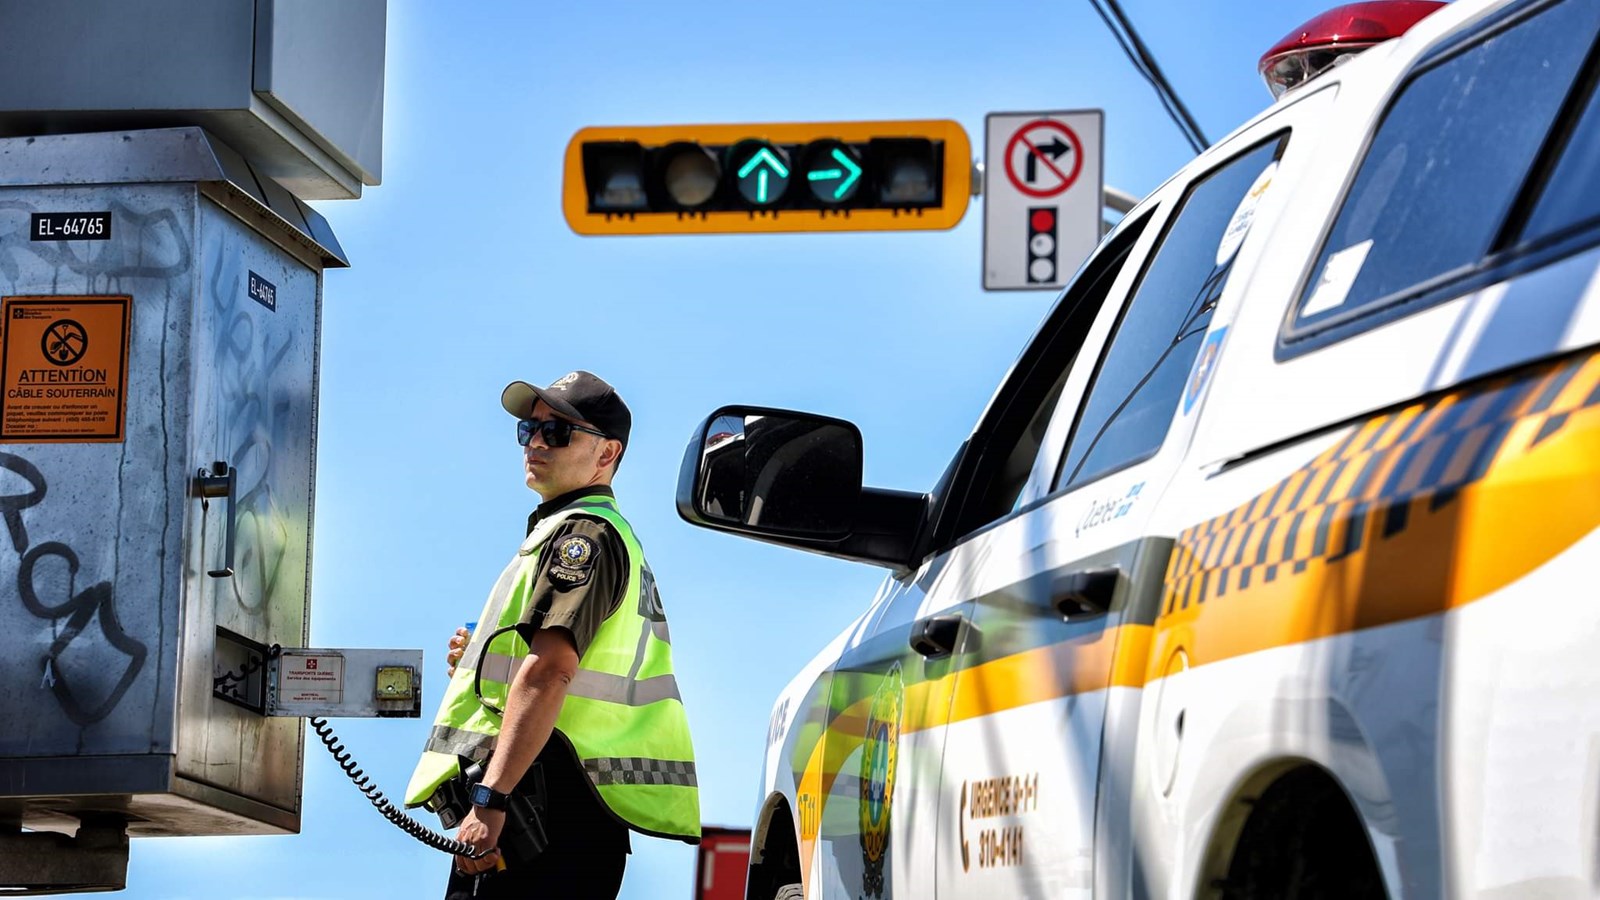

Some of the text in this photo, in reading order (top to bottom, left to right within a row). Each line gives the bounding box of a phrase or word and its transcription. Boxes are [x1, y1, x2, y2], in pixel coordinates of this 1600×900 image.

[39, 217, 104, 236] EL-64765
[251, 277, 274, 306] EL-64765
[8, 387, 43, 398] CÂBLE
[556, 573, 577, 582] POLICE
[970, 772, 1039, 820] URGENCE 9-1-1
[979, 826, 1024, 869] 310-4141
